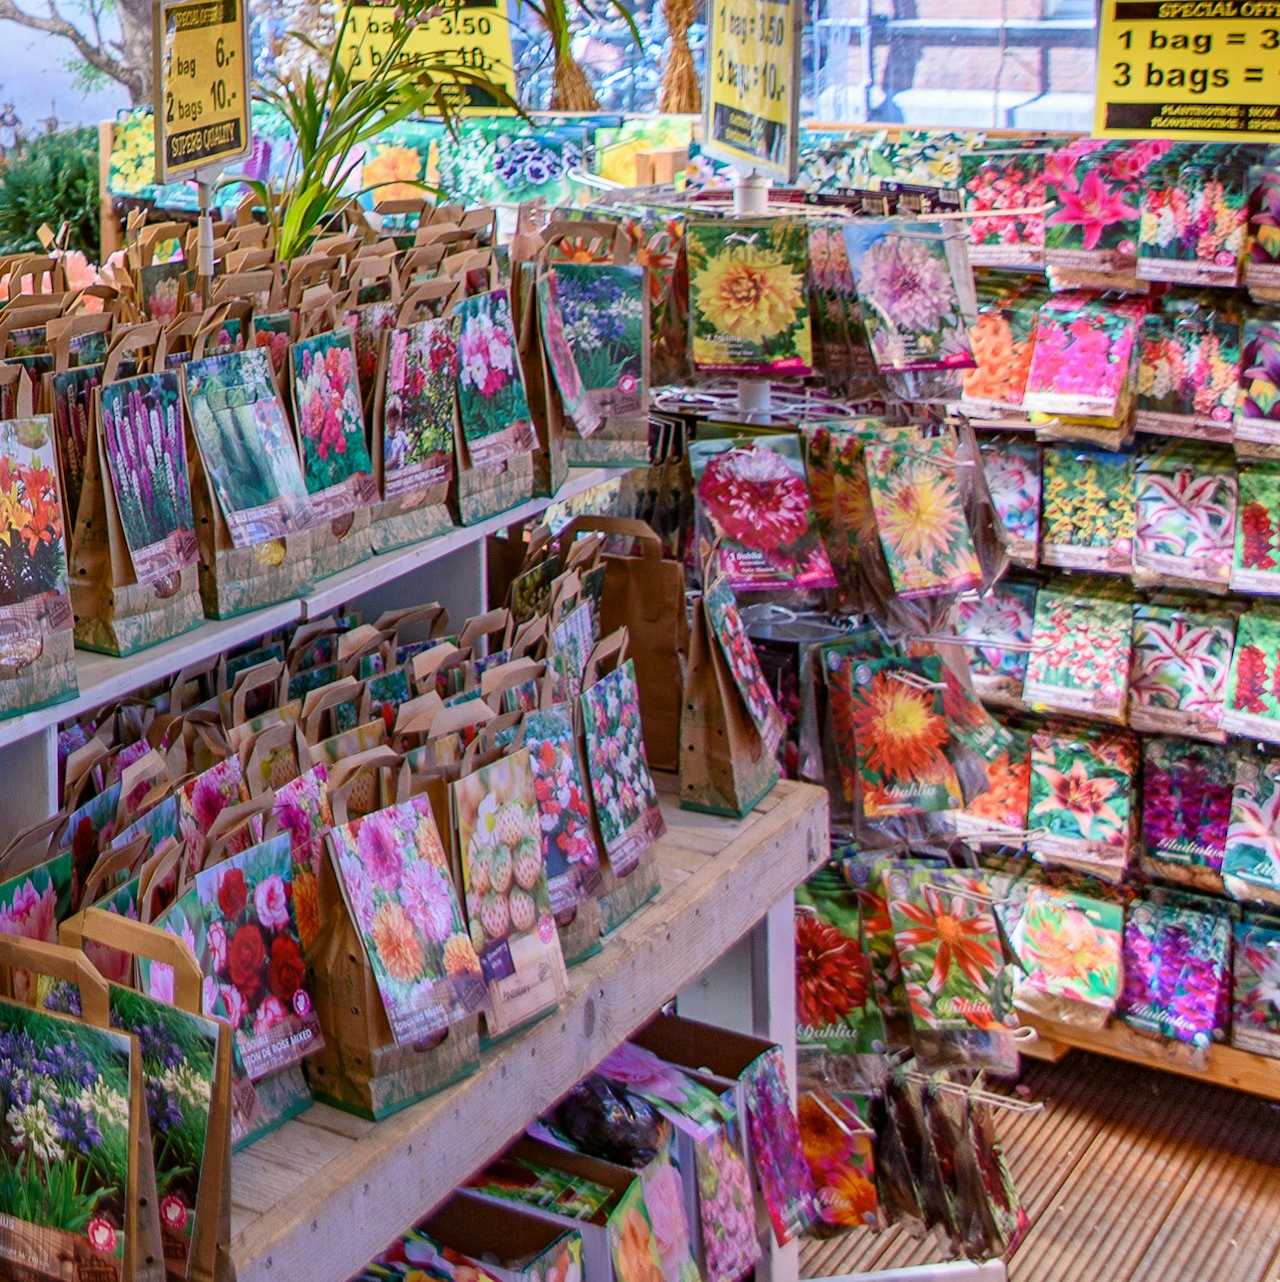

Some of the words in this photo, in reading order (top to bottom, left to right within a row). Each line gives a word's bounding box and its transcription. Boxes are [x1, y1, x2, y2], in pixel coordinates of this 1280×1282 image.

[1158, 1, 1238, 18] SPECIAL
[350, 17, 356, 33] 1
[369, 17, 394, 34] ba
[440, 17, 492, 35] 3.50
[720, 5, 726, 33] 1
[730, 9, 747, 45] bag
[759, 13, 784, 47] 3.50
[1118, 30, 1133, 49] 1
[1149, 30, 1213, 54] bag
[1226, 33, 1246, 45] =
[177, 56, 196, 77] bag
[717, 49, 725, 83] 3
[1113, 62, 1132, 87] 3
[1145, 62, 1229, 94] bags
[1244, 67, 1264, 83] =
[166, 91, 174, 123] 2
[178, 99, 203, 121] bags
[171, 131, 203, 158] SUPERB
[203, 121, 236, 152] QUALITY
[883, 781, 939, 799] Dahlia
[936, 996, 991, 1017] Dahlia
[795, 1020, 859, 1041] Dahlia
[243, 1049, 262, 1066] UTON
[263, 1046, 272, 1058] DE
[272, 1039, 290, 1055] ROSE
[290, 1028, 313, 1048] MIXED
